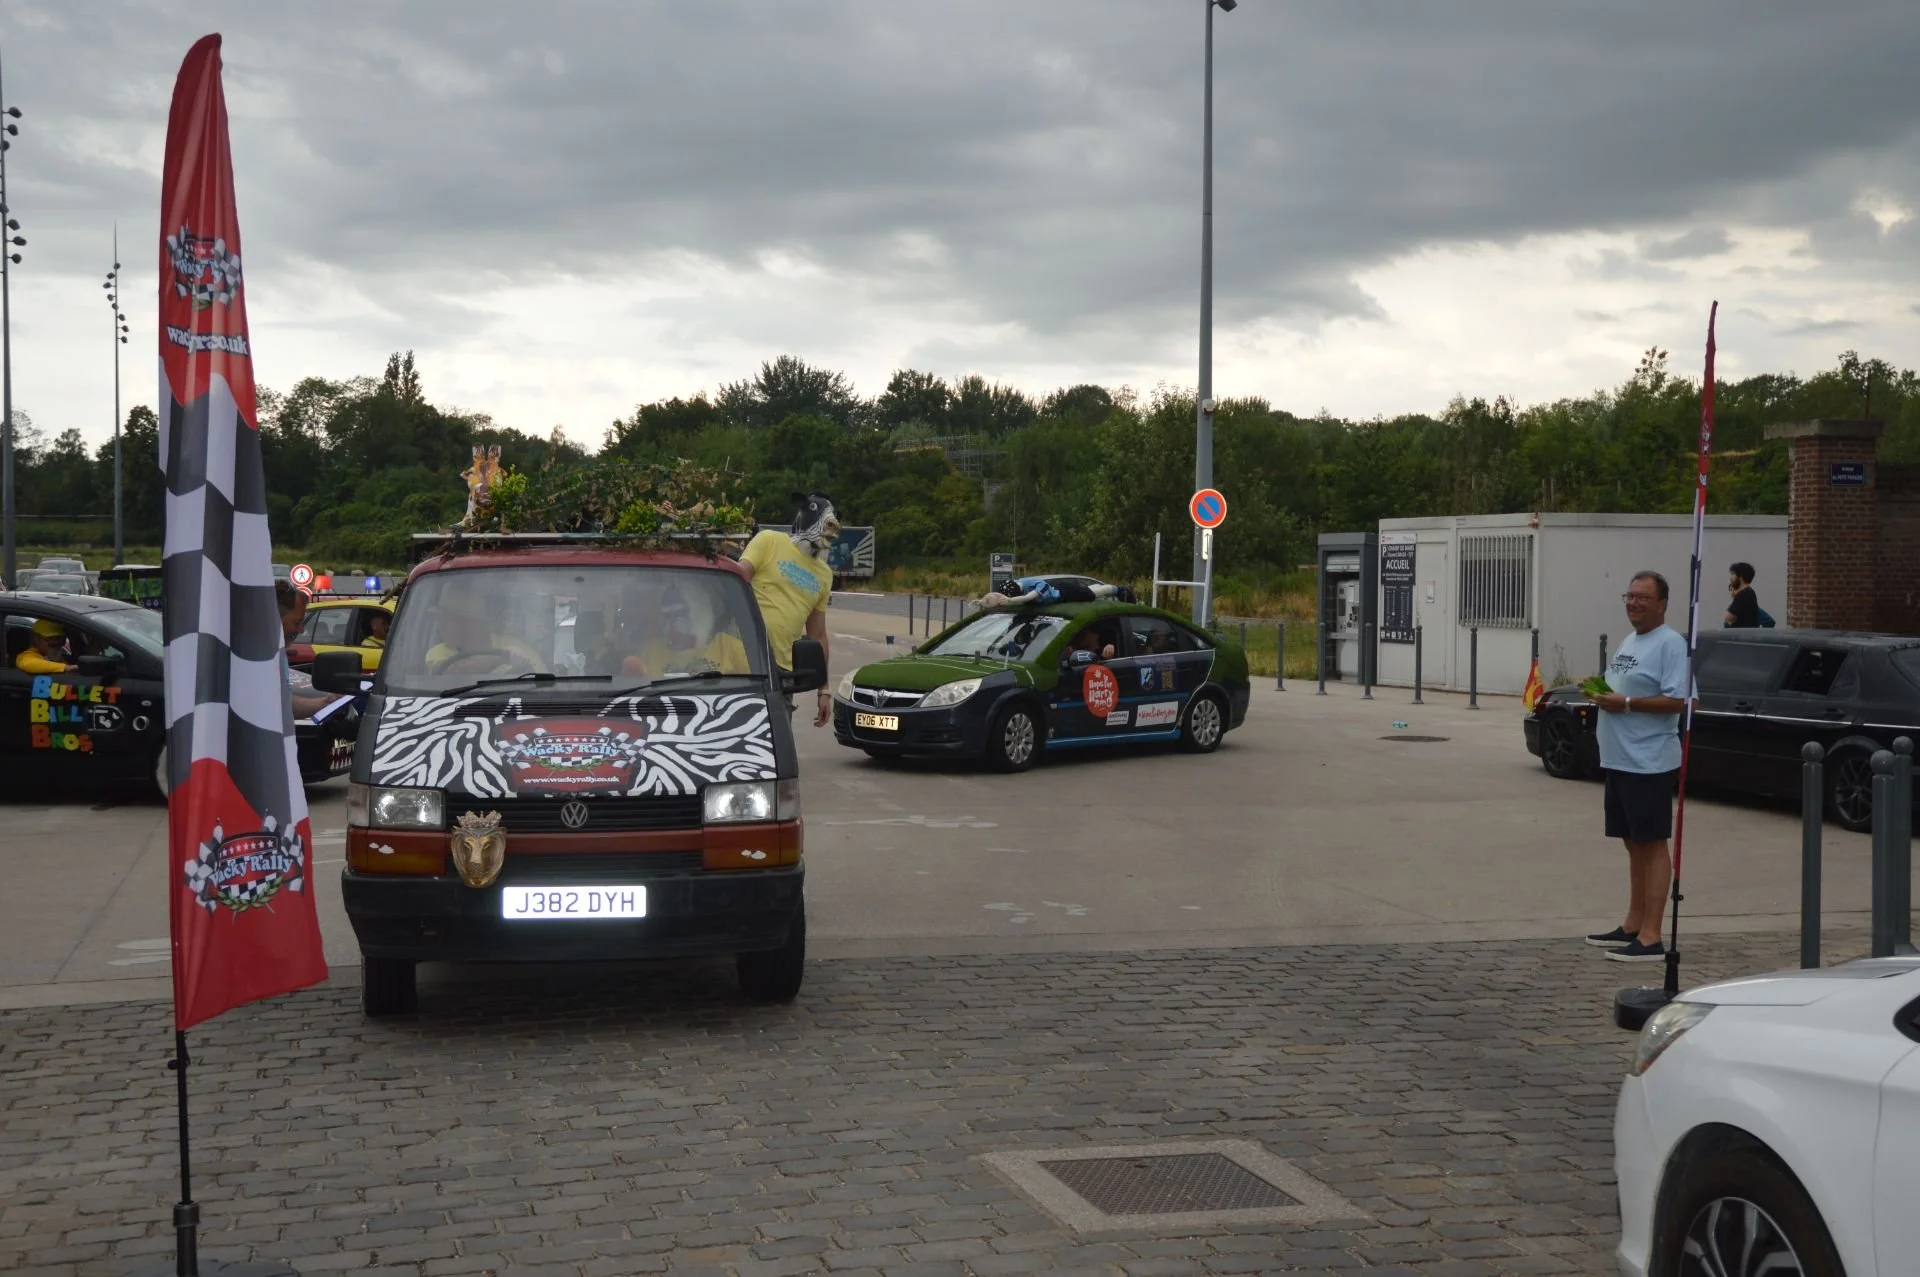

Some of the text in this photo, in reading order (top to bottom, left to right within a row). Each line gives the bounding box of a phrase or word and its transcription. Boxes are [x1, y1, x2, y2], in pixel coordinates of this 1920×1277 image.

[1386, 559, 1410, 569] ACCUEIL
[857, 714, 896, 728] EY06 XTT
[523, 743, 620, 757] Wacky Rally
[523, 775, 620, 784] www.wackyrally.co.uk
[249, 855, 293, 873] Rally
[515, 891, 635, 913] J382 DYH
